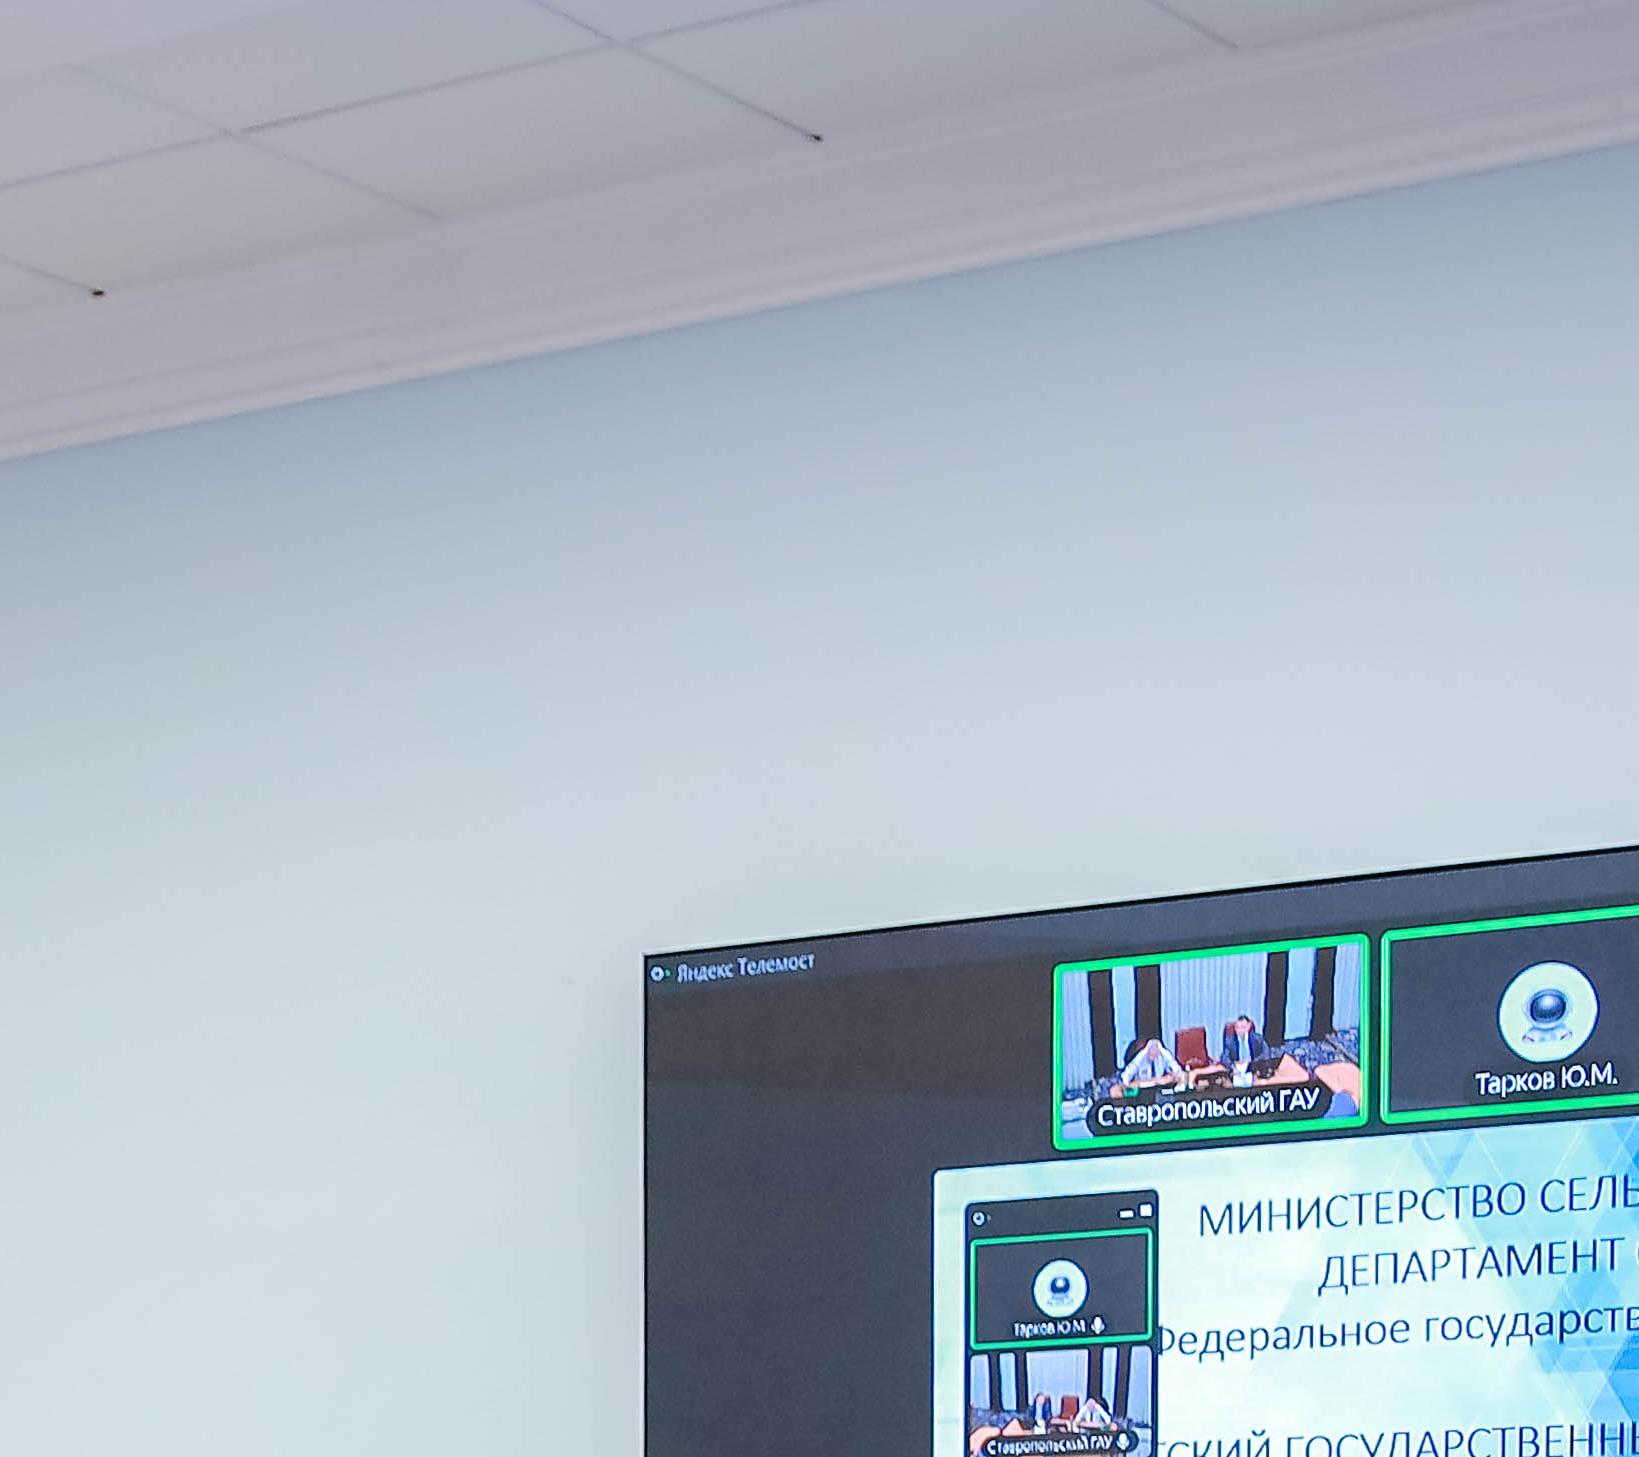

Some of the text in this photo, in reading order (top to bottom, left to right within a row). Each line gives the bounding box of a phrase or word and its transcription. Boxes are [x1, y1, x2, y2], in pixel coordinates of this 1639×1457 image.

[677, 953, 815, 983] Яндекс Телемост
[1476, 1063, 1618, 1097] Тарков Ю.М.
[1097, 1087, 1320, 1128] Ставропольский ГАУ
[1199, 1180, 1526, 1238] МИНИСТЕРСТВО
[1316, 1236, 1625, 1298] ДЕПАРТАМЕНТ
